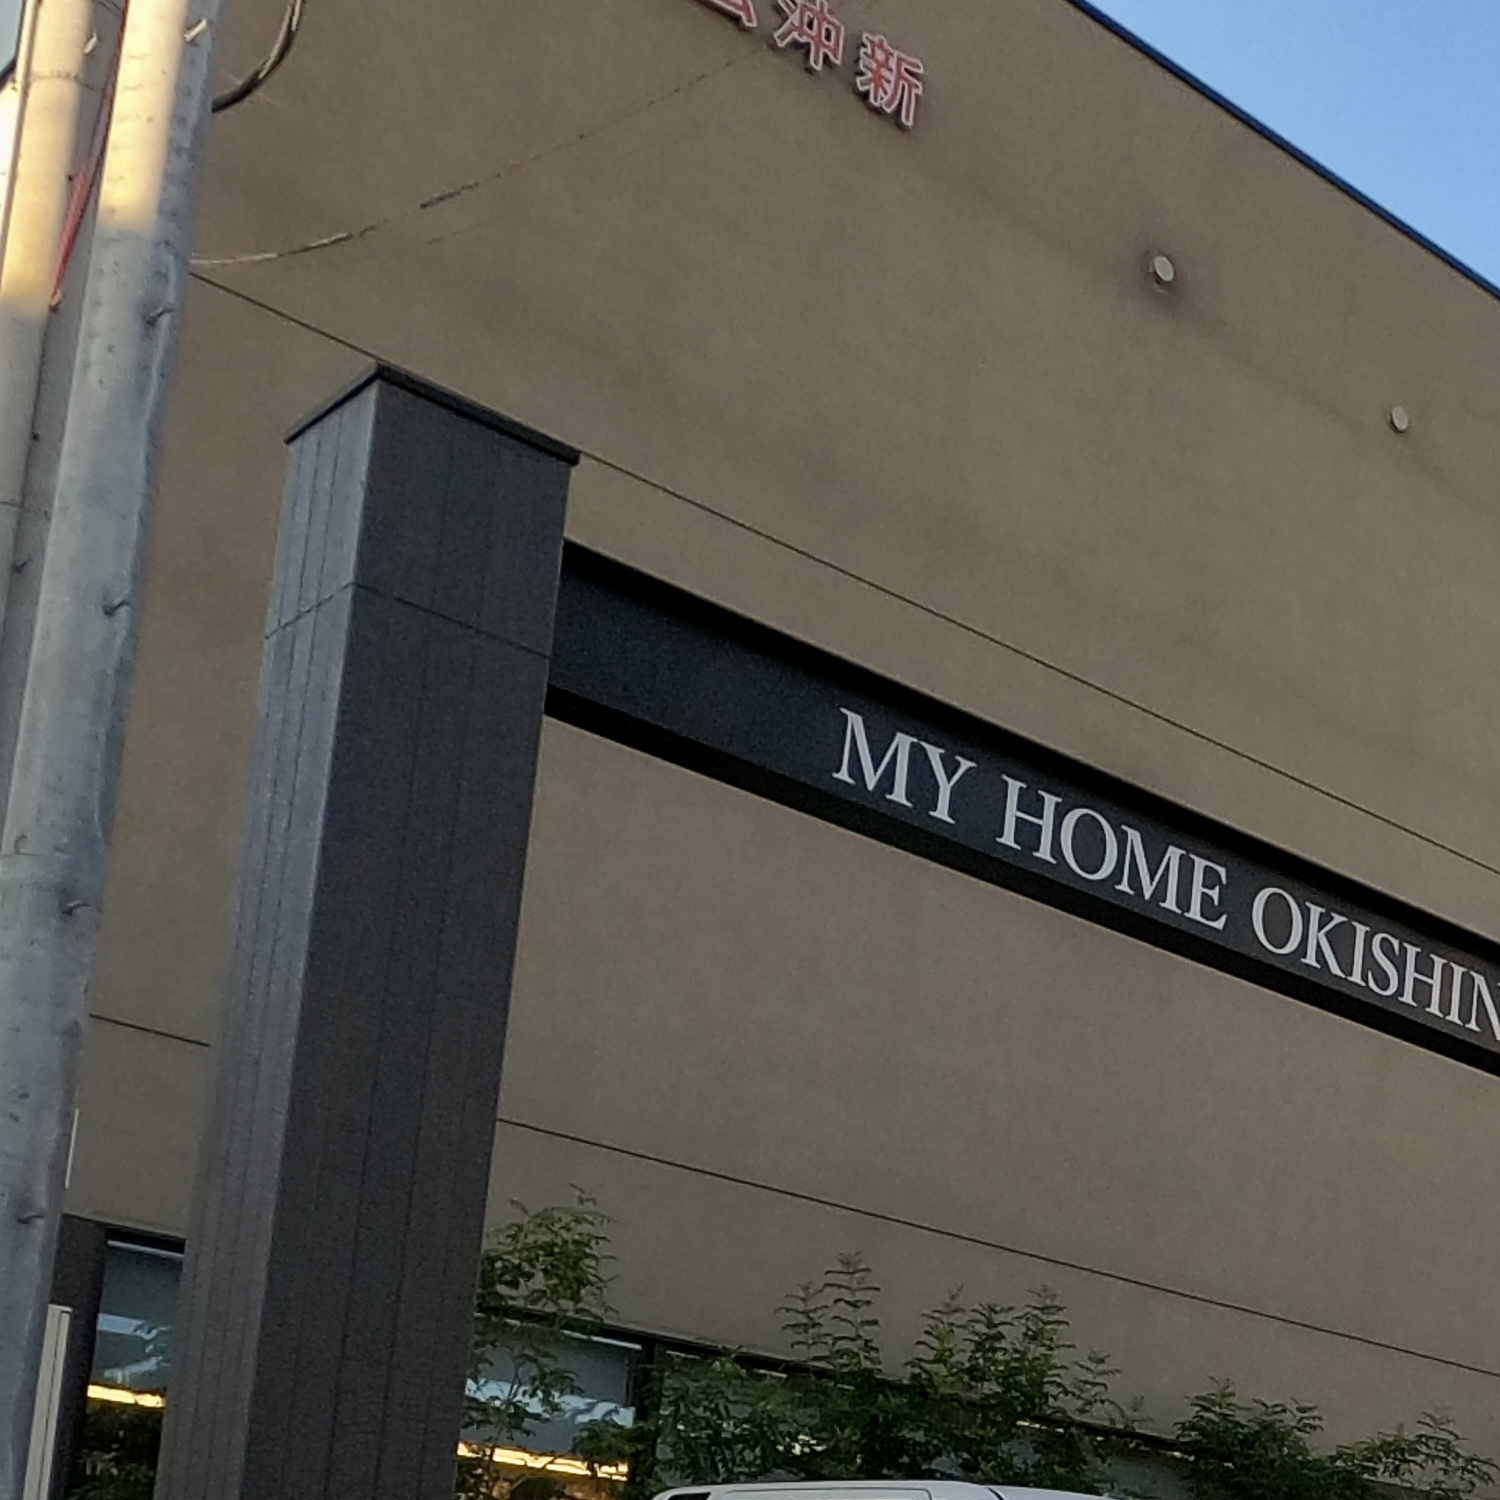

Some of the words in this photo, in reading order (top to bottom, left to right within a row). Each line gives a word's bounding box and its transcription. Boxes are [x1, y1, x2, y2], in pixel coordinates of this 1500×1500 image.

[698, 0, 924, 127] 沖新
[831, 707, 977, 824] MY
[996, 774, 1228, 932] HOME
